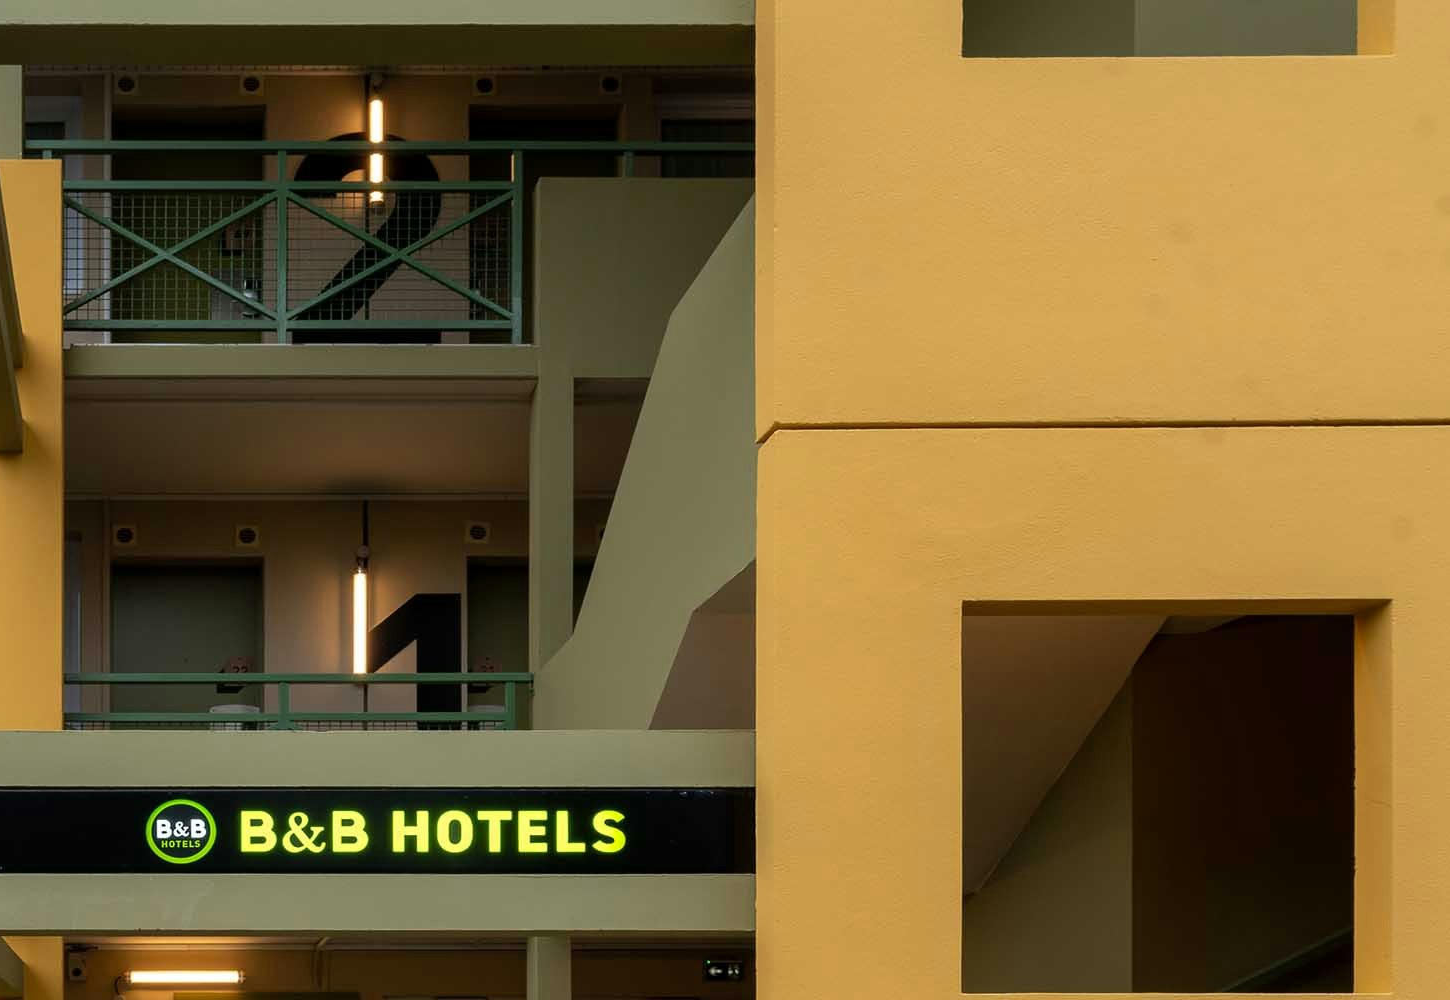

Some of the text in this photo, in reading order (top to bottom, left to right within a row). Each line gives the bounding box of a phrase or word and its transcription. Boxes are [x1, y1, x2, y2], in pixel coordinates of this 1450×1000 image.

[293, 132, 442, 345] 2
[365, 593, 462, 730] 1
[156, 819, 207, 839] B&B
[161, 840, 201, 848] HOTELS
[240, 810, 626, 853] B&B HOTELS
